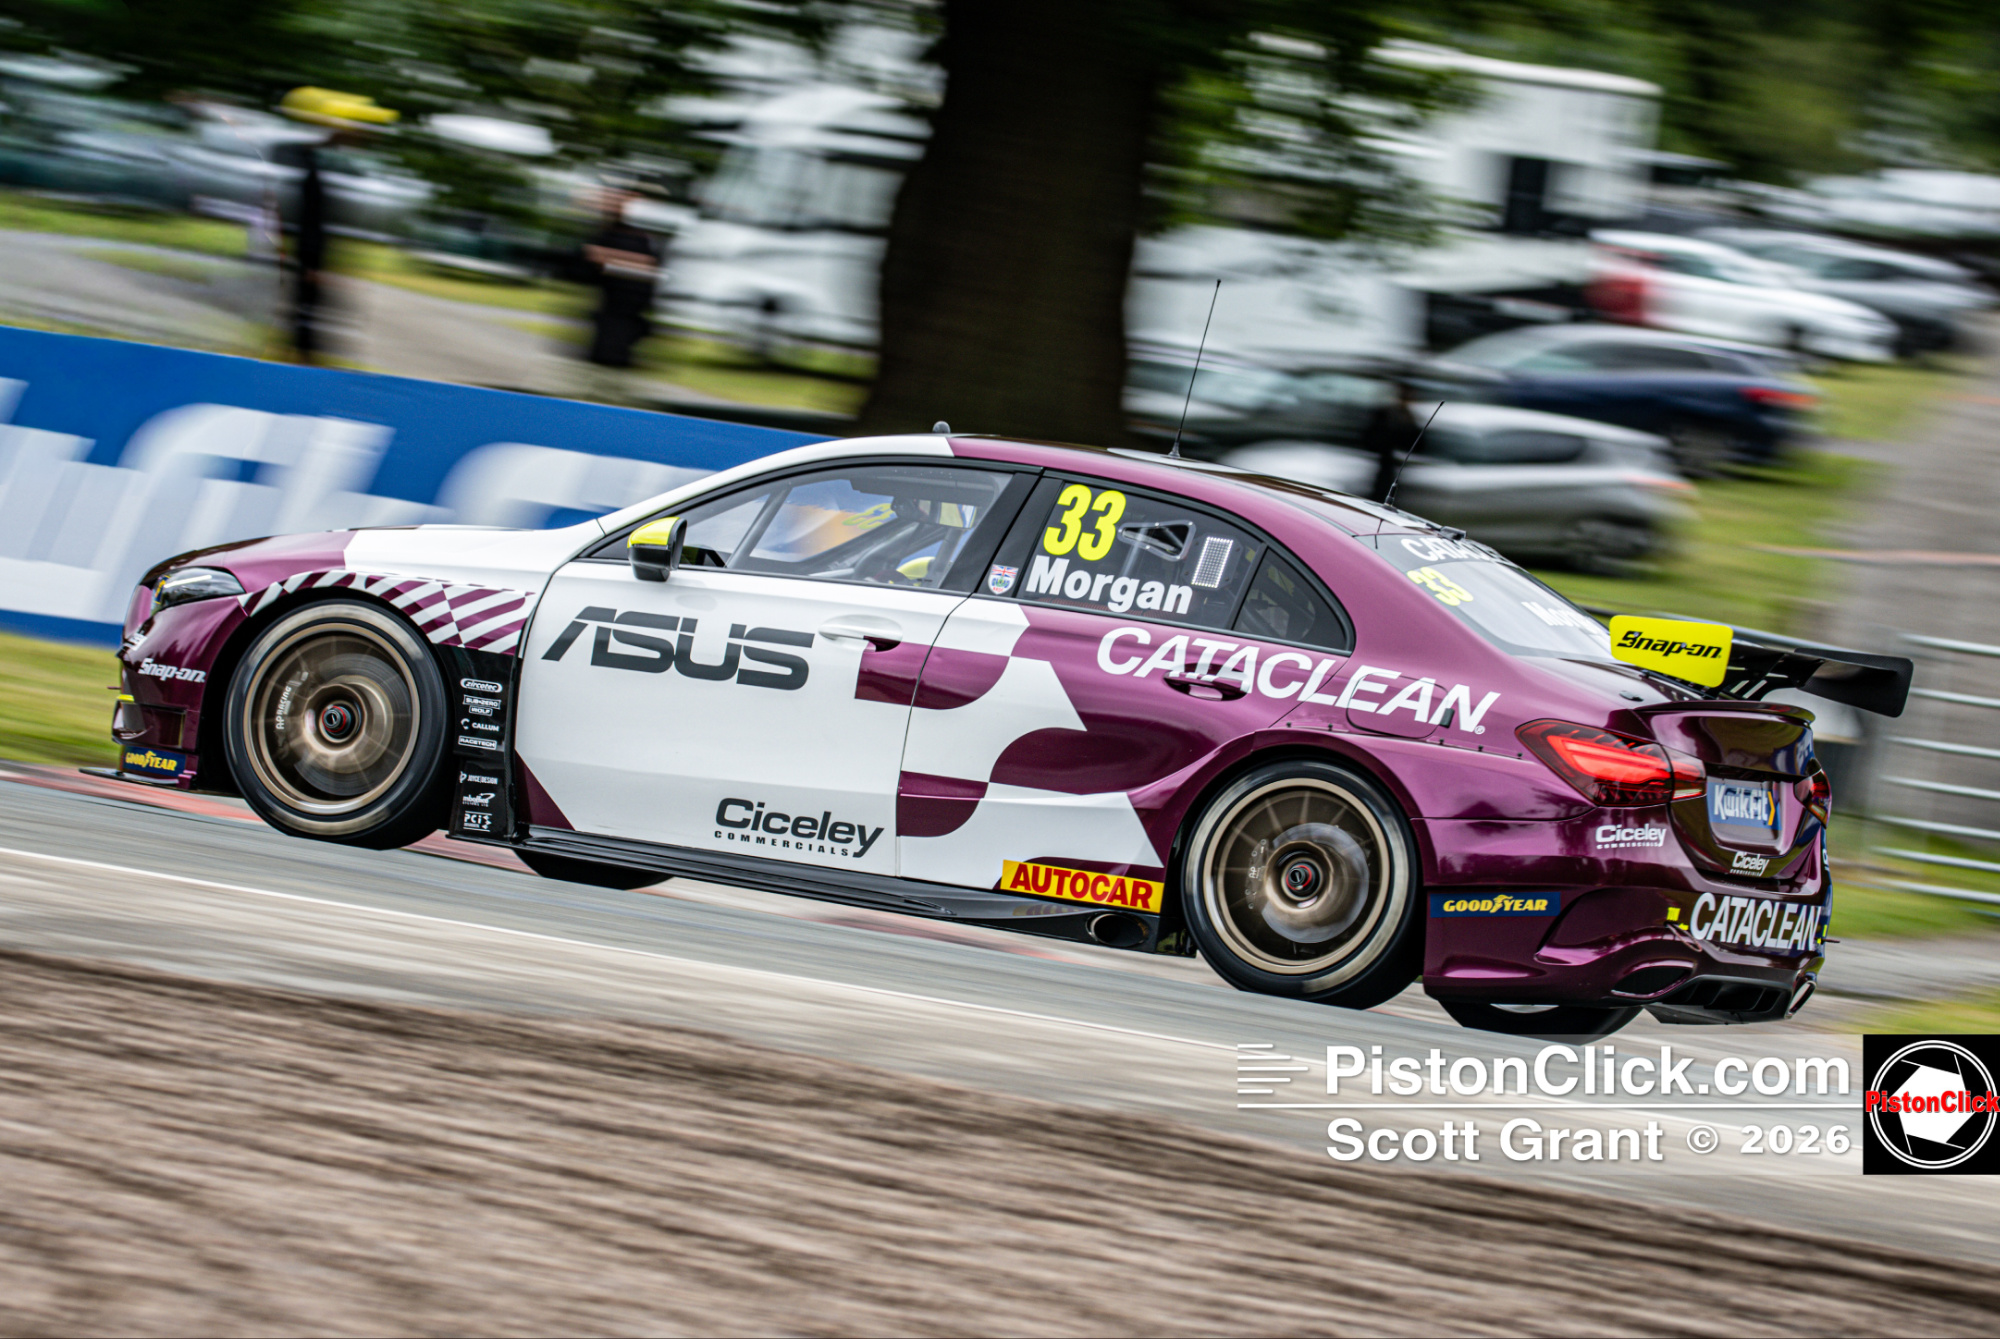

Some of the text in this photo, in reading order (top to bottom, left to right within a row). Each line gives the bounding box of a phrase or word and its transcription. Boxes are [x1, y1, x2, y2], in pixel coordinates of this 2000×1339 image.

[1043, 484, 1127, 561] 33
[1025, 555, 1193, 613] Morgan
[1407, 566, 1474, 606] 33
[541, 606, 815, 691] ASUS
[471, 722, 499, 732] CALLUM
[714, 831, 848, 856] COMMERCIALS
[716, 797, 885, 858] Ciceley
[1595, 823, 1666, 848] Ciceley
[1010, 863, 1153, 909] AUTOCAR
[1732, 851, 1770, 877] Ciceley
[1690, 892, 1822, 951] CATACLEAN
